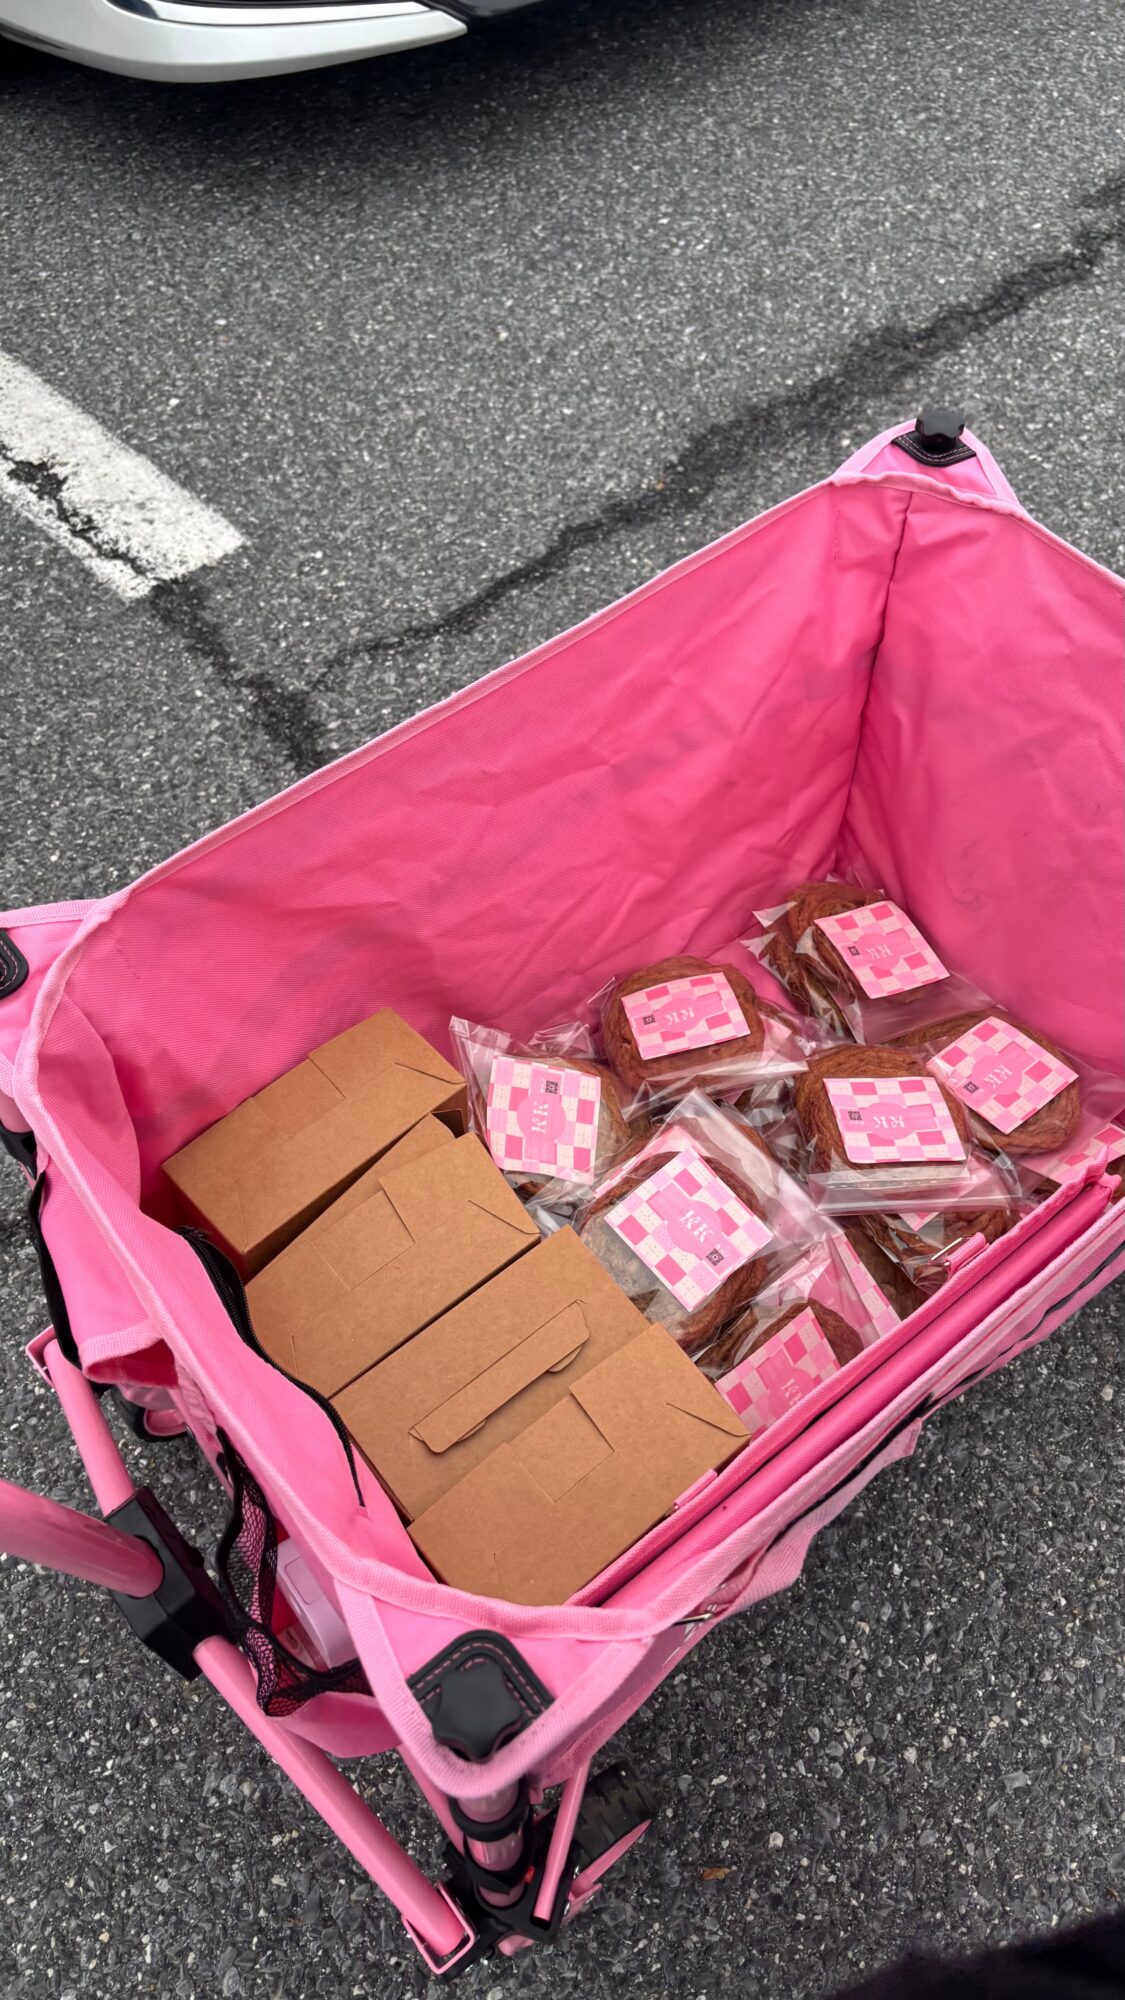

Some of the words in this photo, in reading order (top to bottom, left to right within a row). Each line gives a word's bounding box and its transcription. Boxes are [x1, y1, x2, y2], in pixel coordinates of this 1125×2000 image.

[866, 944, 892, 960] KK
[665, 1007, 695, 1026] KK
[983, 1065, 1013, 1088] KK
[532, 1100, 549, 1134] KK
[872, 1116, 905, 1128] KK
[681, 1209, 714, 1244] KK
